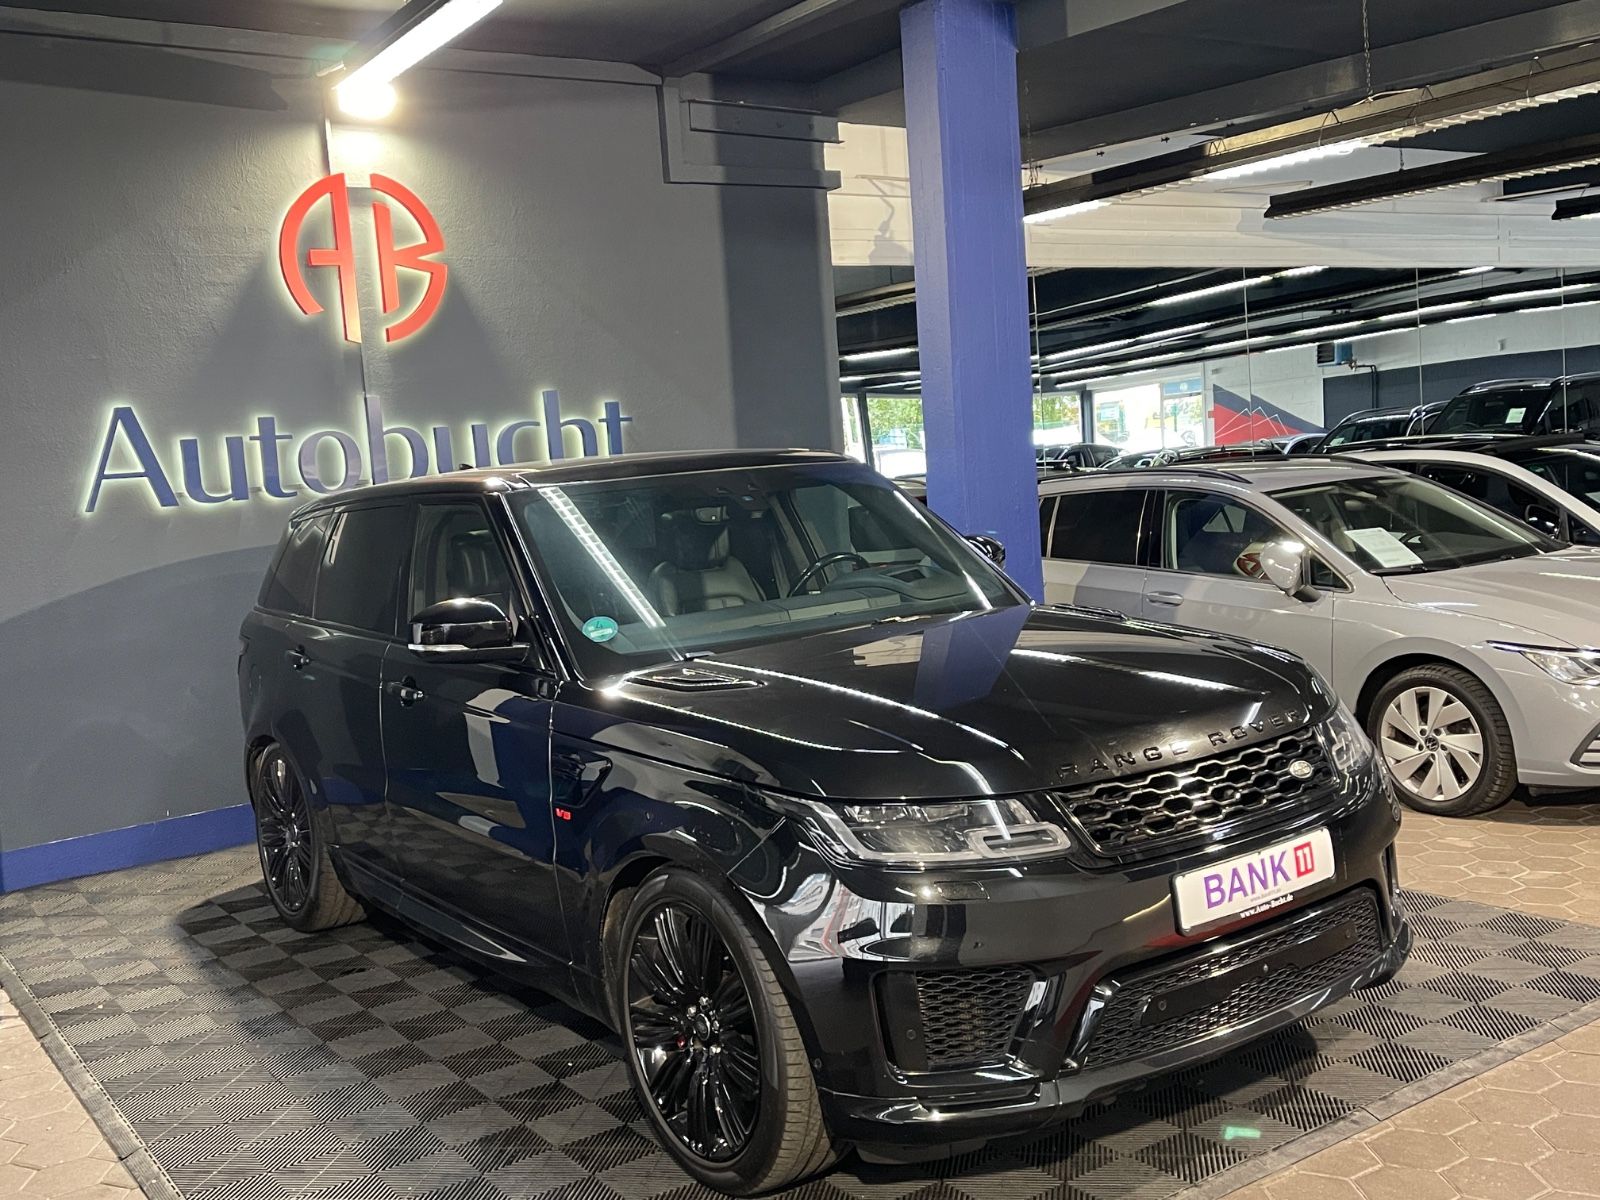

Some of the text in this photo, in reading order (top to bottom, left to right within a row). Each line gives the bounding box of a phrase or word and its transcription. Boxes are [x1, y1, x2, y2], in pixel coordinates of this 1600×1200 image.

[278, 172, 449, 344] AB
[85, 389, 634, 514] Autobucht
[1056, 709, 1301, 782] RANGE ROVER
[1203, 850, 1291, 910] BANK
